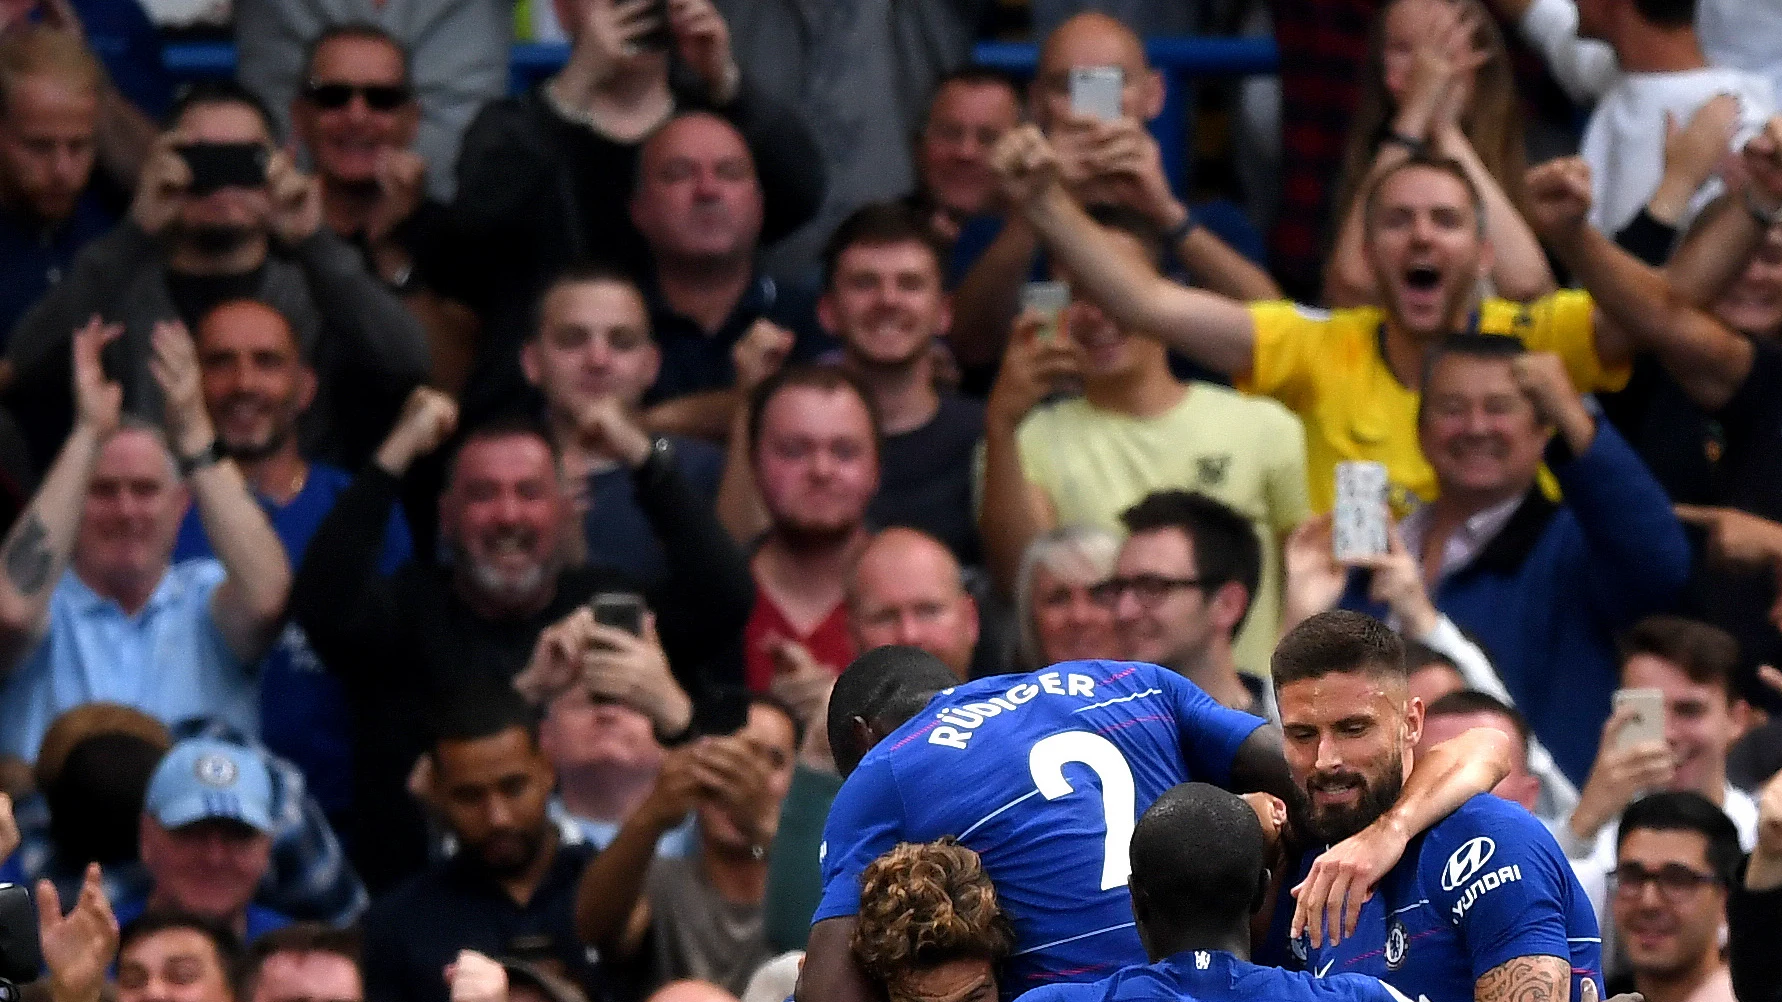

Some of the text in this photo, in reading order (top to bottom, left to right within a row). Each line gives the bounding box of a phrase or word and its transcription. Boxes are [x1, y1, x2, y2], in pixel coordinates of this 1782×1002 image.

[929, 672, 1095, 750] RÜDIGER
[1029, 731, 1135, 890] 2
[1452, 864, 1522, 924] YUNDAI
